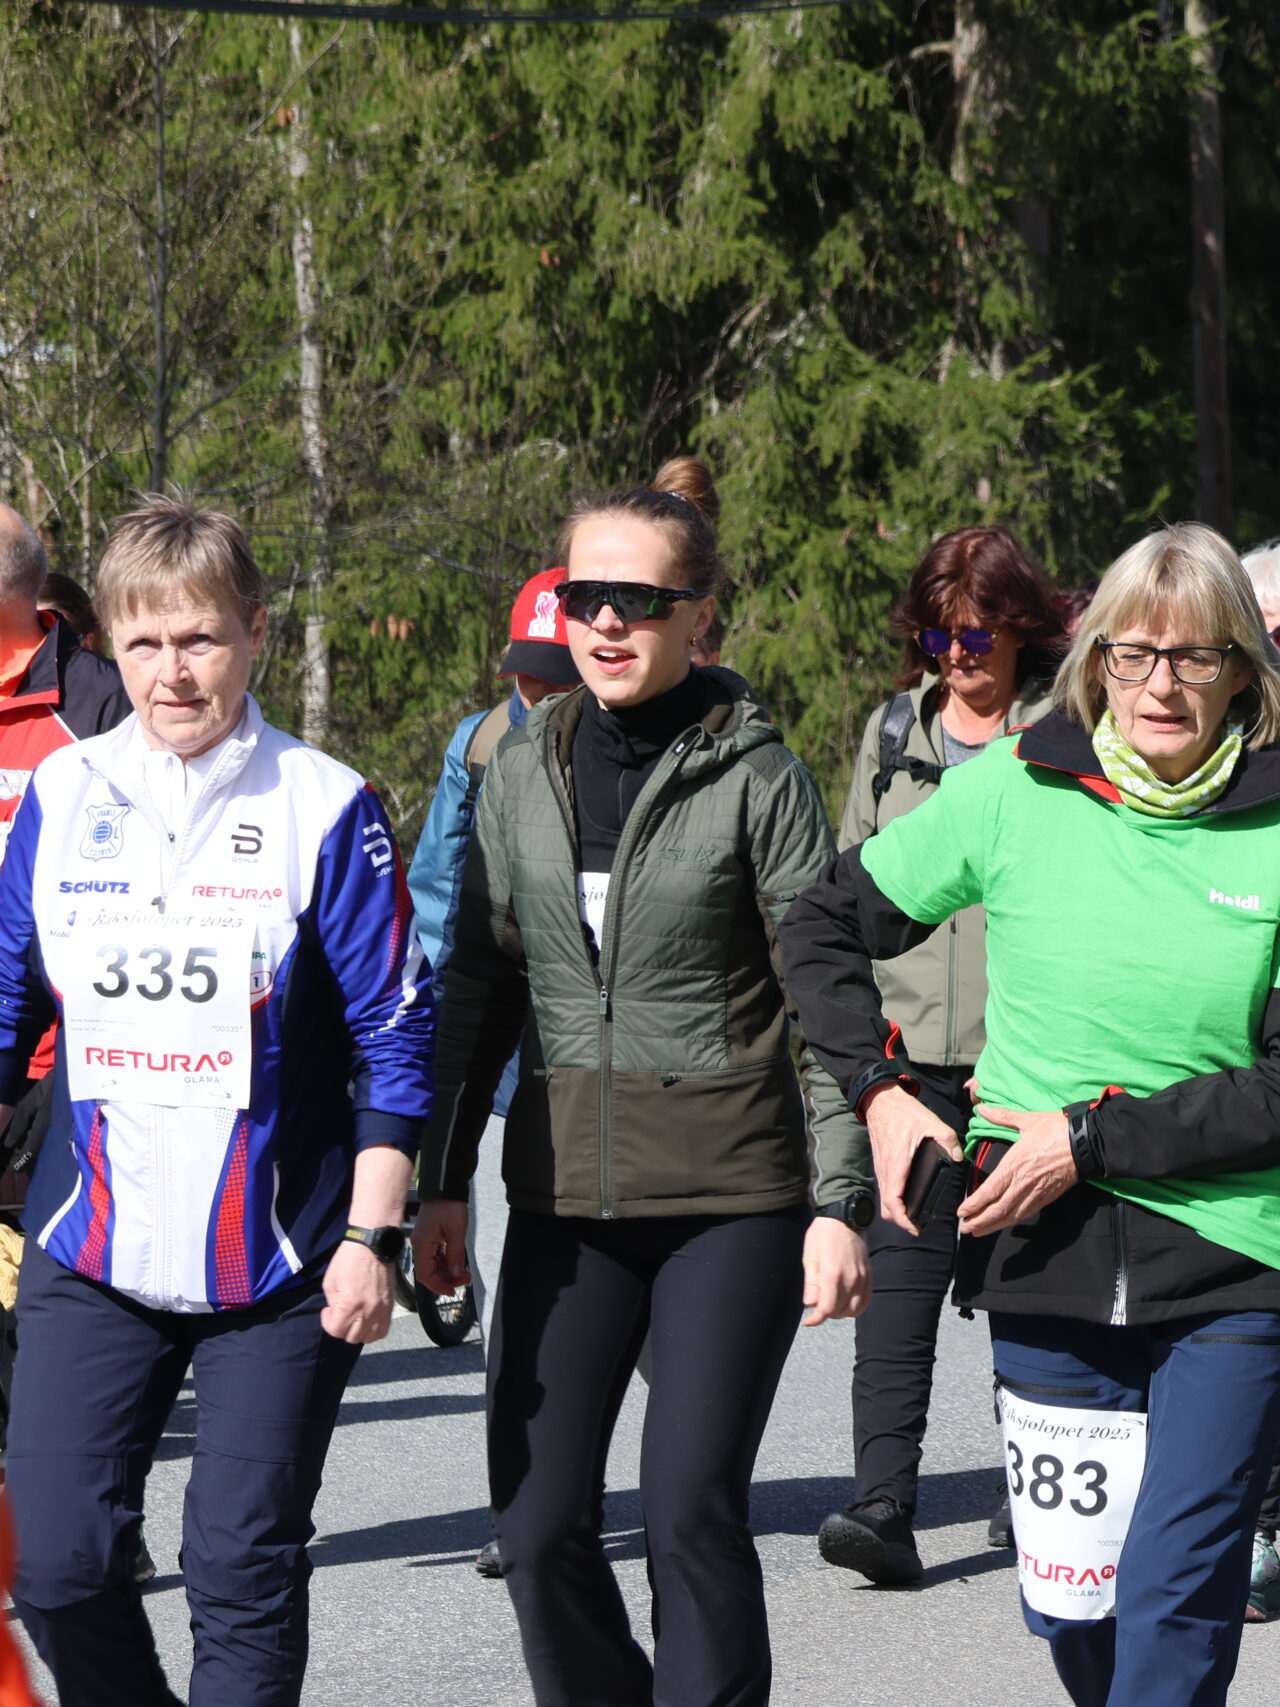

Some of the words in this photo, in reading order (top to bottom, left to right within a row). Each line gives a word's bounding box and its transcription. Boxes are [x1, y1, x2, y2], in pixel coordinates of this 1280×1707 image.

[59, 880, 130, 894] SCHÜTZ
[192, 885, 273, 900] RETURA
[1209, 888, 1260, 911] Heidi
[200, 915, 244, 928] 2025
[93, 944, 218, 1003] 335
[85, 1047, 218, 1072] RETURA
[1088, 1426, 1131, 1441] 2025
[1007, 1440, 1108, 1517] 383
[1020, 1549, 1101, 1586] TURA
